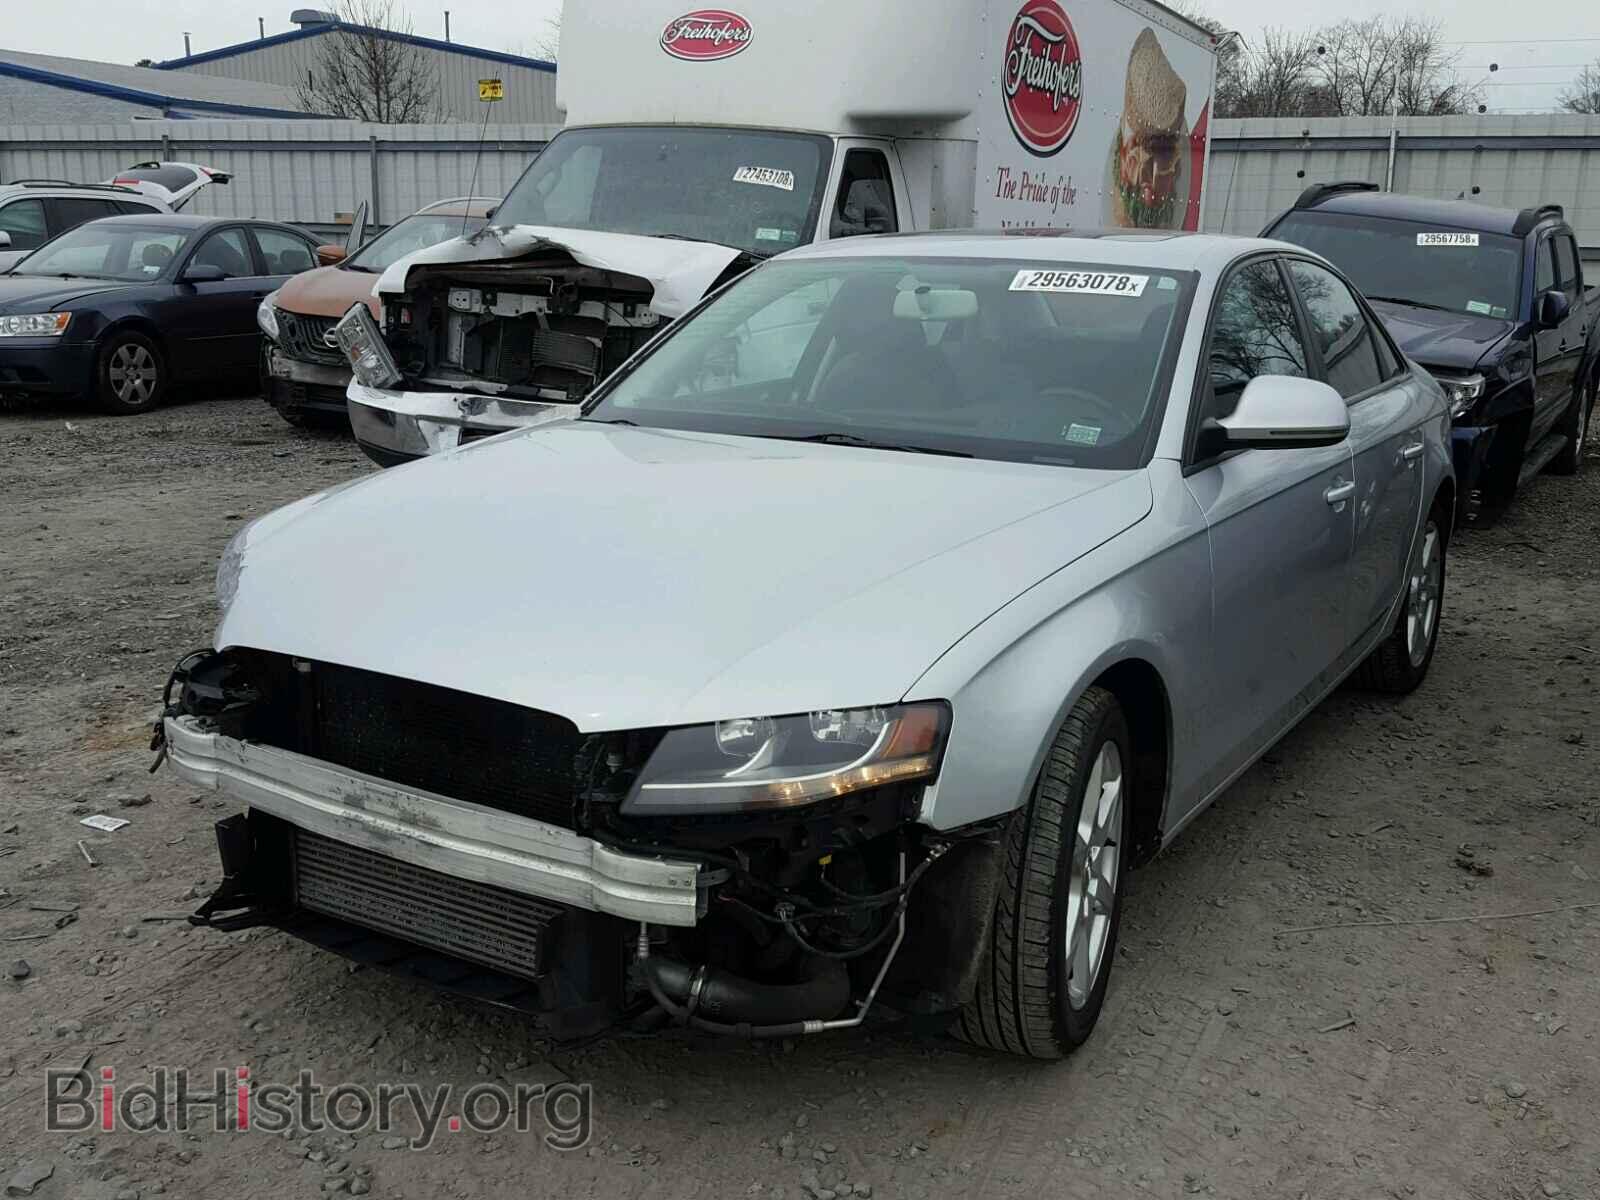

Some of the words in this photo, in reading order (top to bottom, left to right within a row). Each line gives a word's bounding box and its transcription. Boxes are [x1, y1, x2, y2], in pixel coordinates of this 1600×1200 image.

[662, 16, 752, 46] Freihofer's
[1005, 14, 1081, 112] Freihofer's
[995, 167, 1017, 200] The
[1018, 171, 1049, 203] Pride
[1050, 175, 1064, 214] of
[1062, 175, 1077, 205] the
